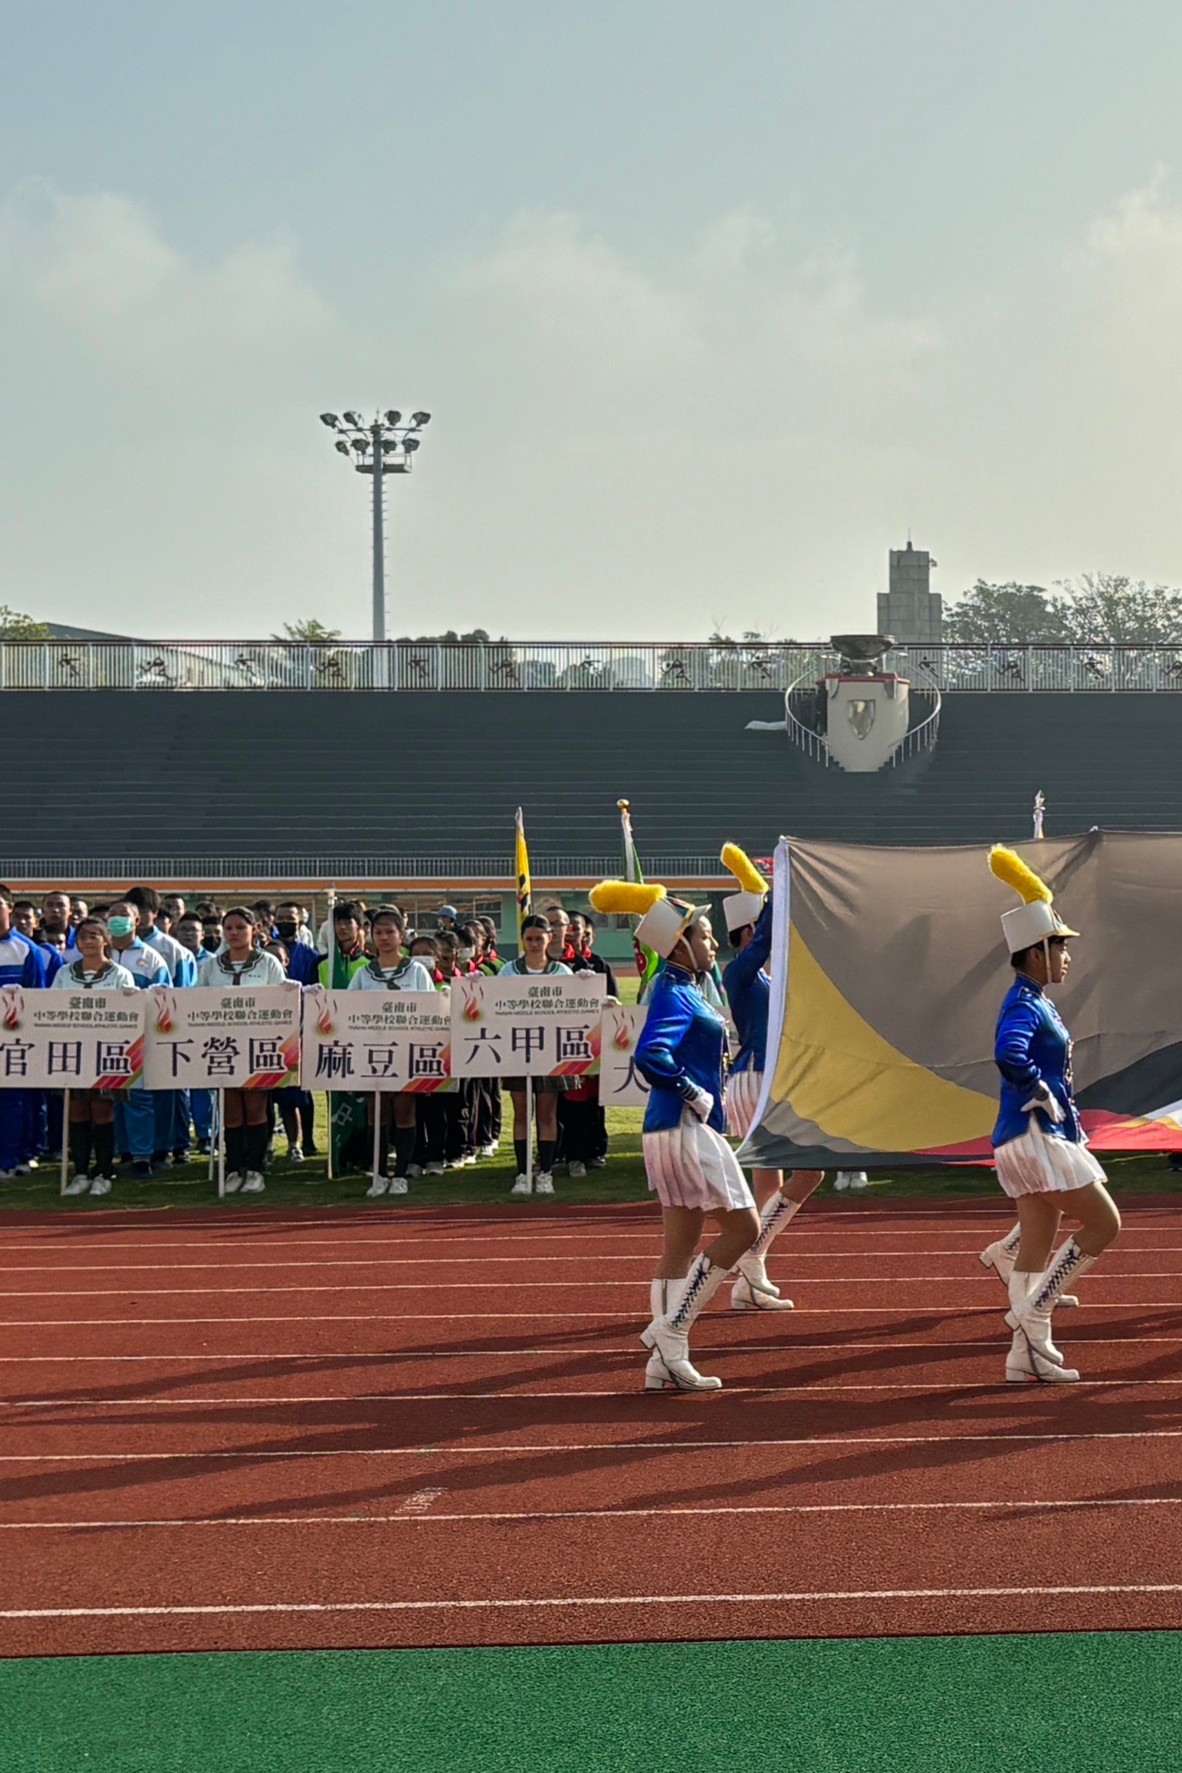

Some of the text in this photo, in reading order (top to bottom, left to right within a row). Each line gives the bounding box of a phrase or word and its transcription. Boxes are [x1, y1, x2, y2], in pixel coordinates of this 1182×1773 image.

[0, 1038, 131, 1076] 官田區
[156, 1035, 286, 1077] 下營區
[315, 1040, 444, 1079] 麻豆區
[464, 1024, 592, 1065] 六甲區
